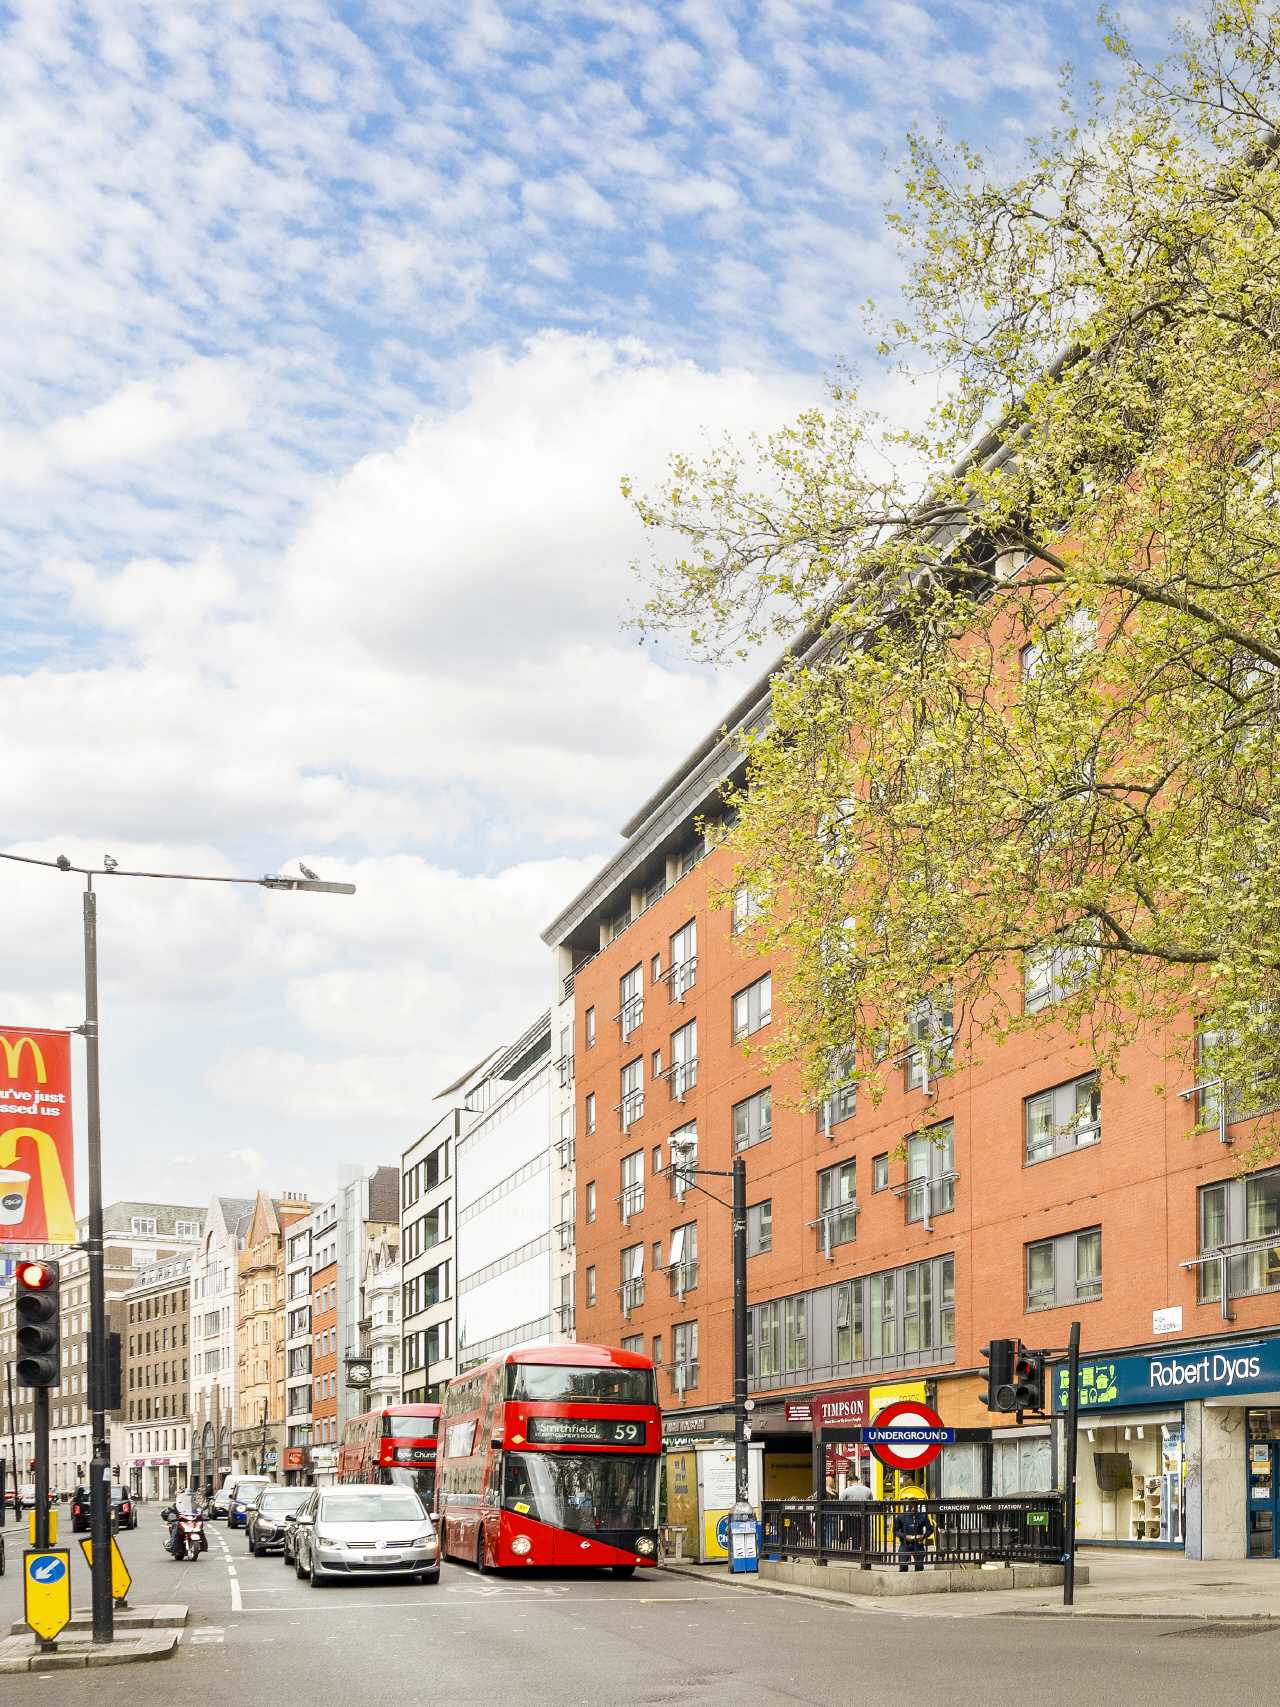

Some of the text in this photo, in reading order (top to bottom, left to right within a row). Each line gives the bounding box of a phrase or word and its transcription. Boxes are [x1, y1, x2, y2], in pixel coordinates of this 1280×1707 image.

[0, 1088, 66, 1104] u've just
[0, 1104, 61, 1116] ssed us
[1150, 1356, 1260, 1388] Robert Dyas
[821, 1400, 864, 1418] TIMPSON
[540, 1423, 638, 1440] Smithfield 59
[868, 1431, 948, 1440] UNDERGROUND
